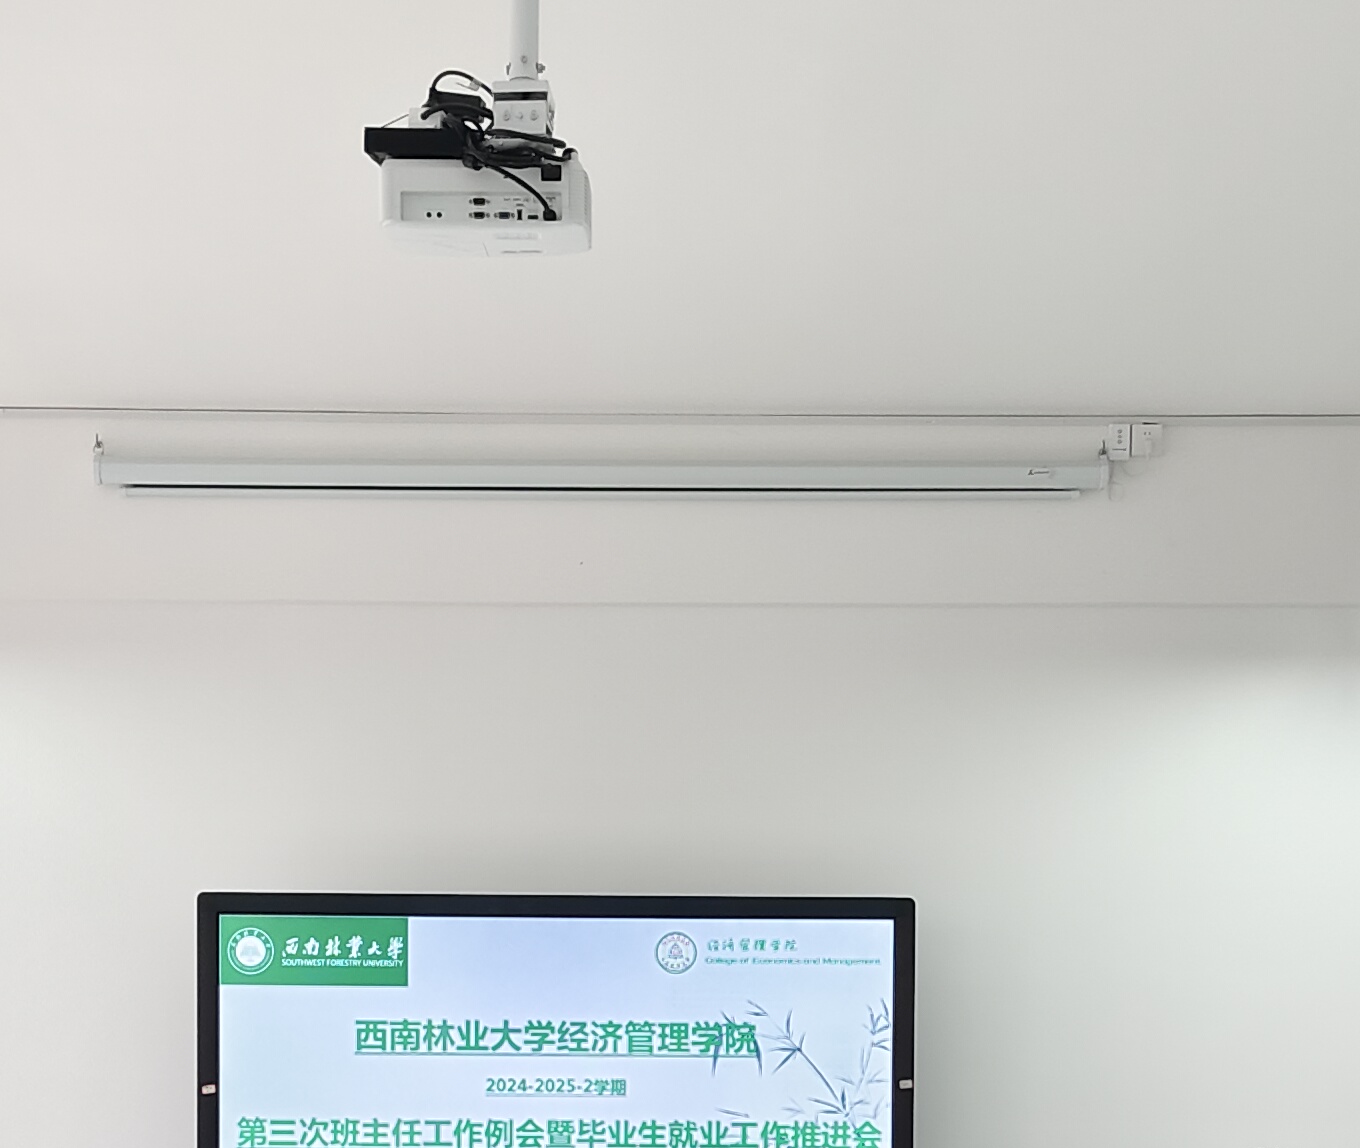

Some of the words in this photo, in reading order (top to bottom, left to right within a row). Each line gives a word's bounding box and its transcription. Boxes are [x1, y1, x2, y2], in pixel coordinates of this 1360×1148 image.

[281, 958, 326, 967] SOUTHWEST
[327, 958, 361, 967] FORESTRY
[362, 958, 403, 967] UNIVERSITY
[354, 1018, 758, 1055] 西南林业大学经济管理学院
[485, 1077, 627, 1096] 2024-2025-2学期
